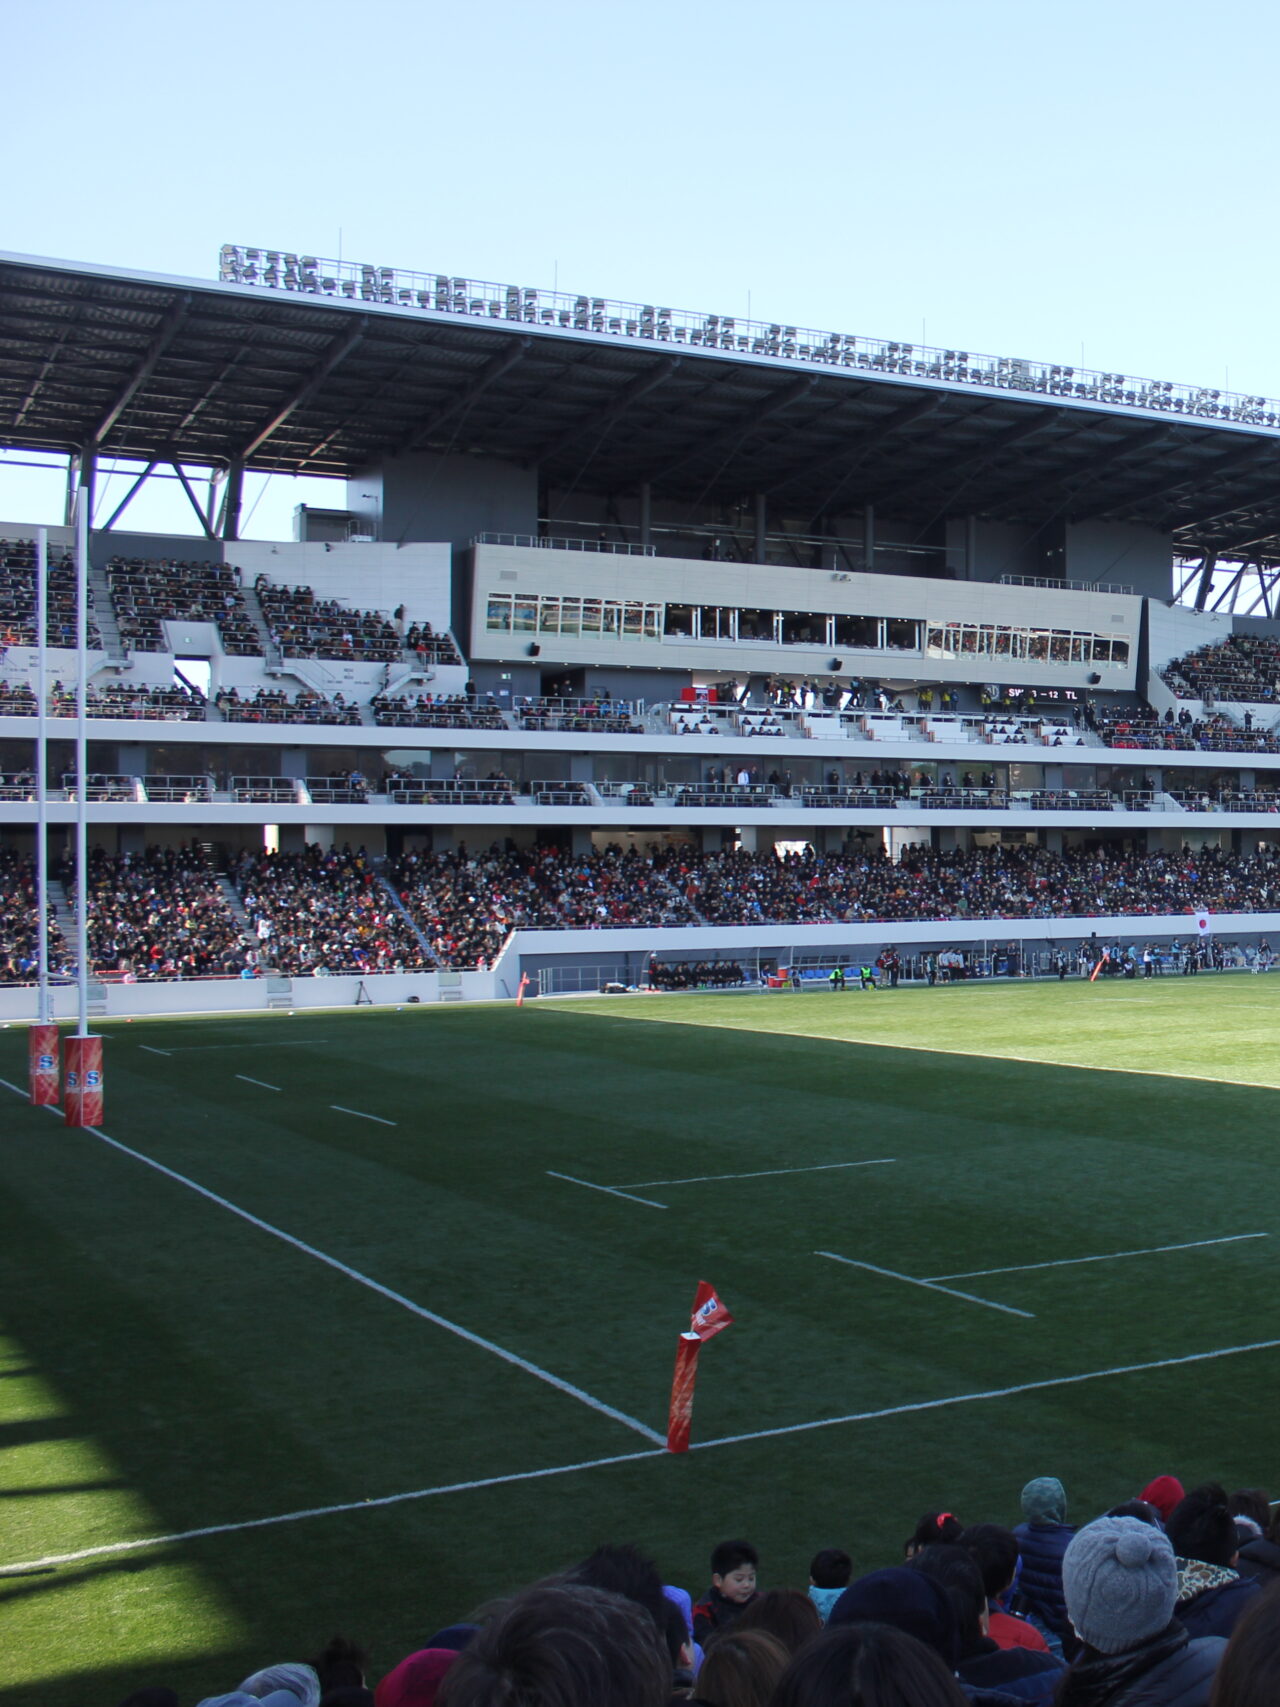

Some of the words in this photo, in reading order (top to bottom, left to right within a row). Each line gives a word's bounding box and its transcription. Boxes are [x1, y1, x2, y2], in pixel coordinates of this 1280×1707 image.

[1065, 691, 1078, 700] TL
[40, 1055, 53, 1069] S
[86, 1071, 99, 1086] S
